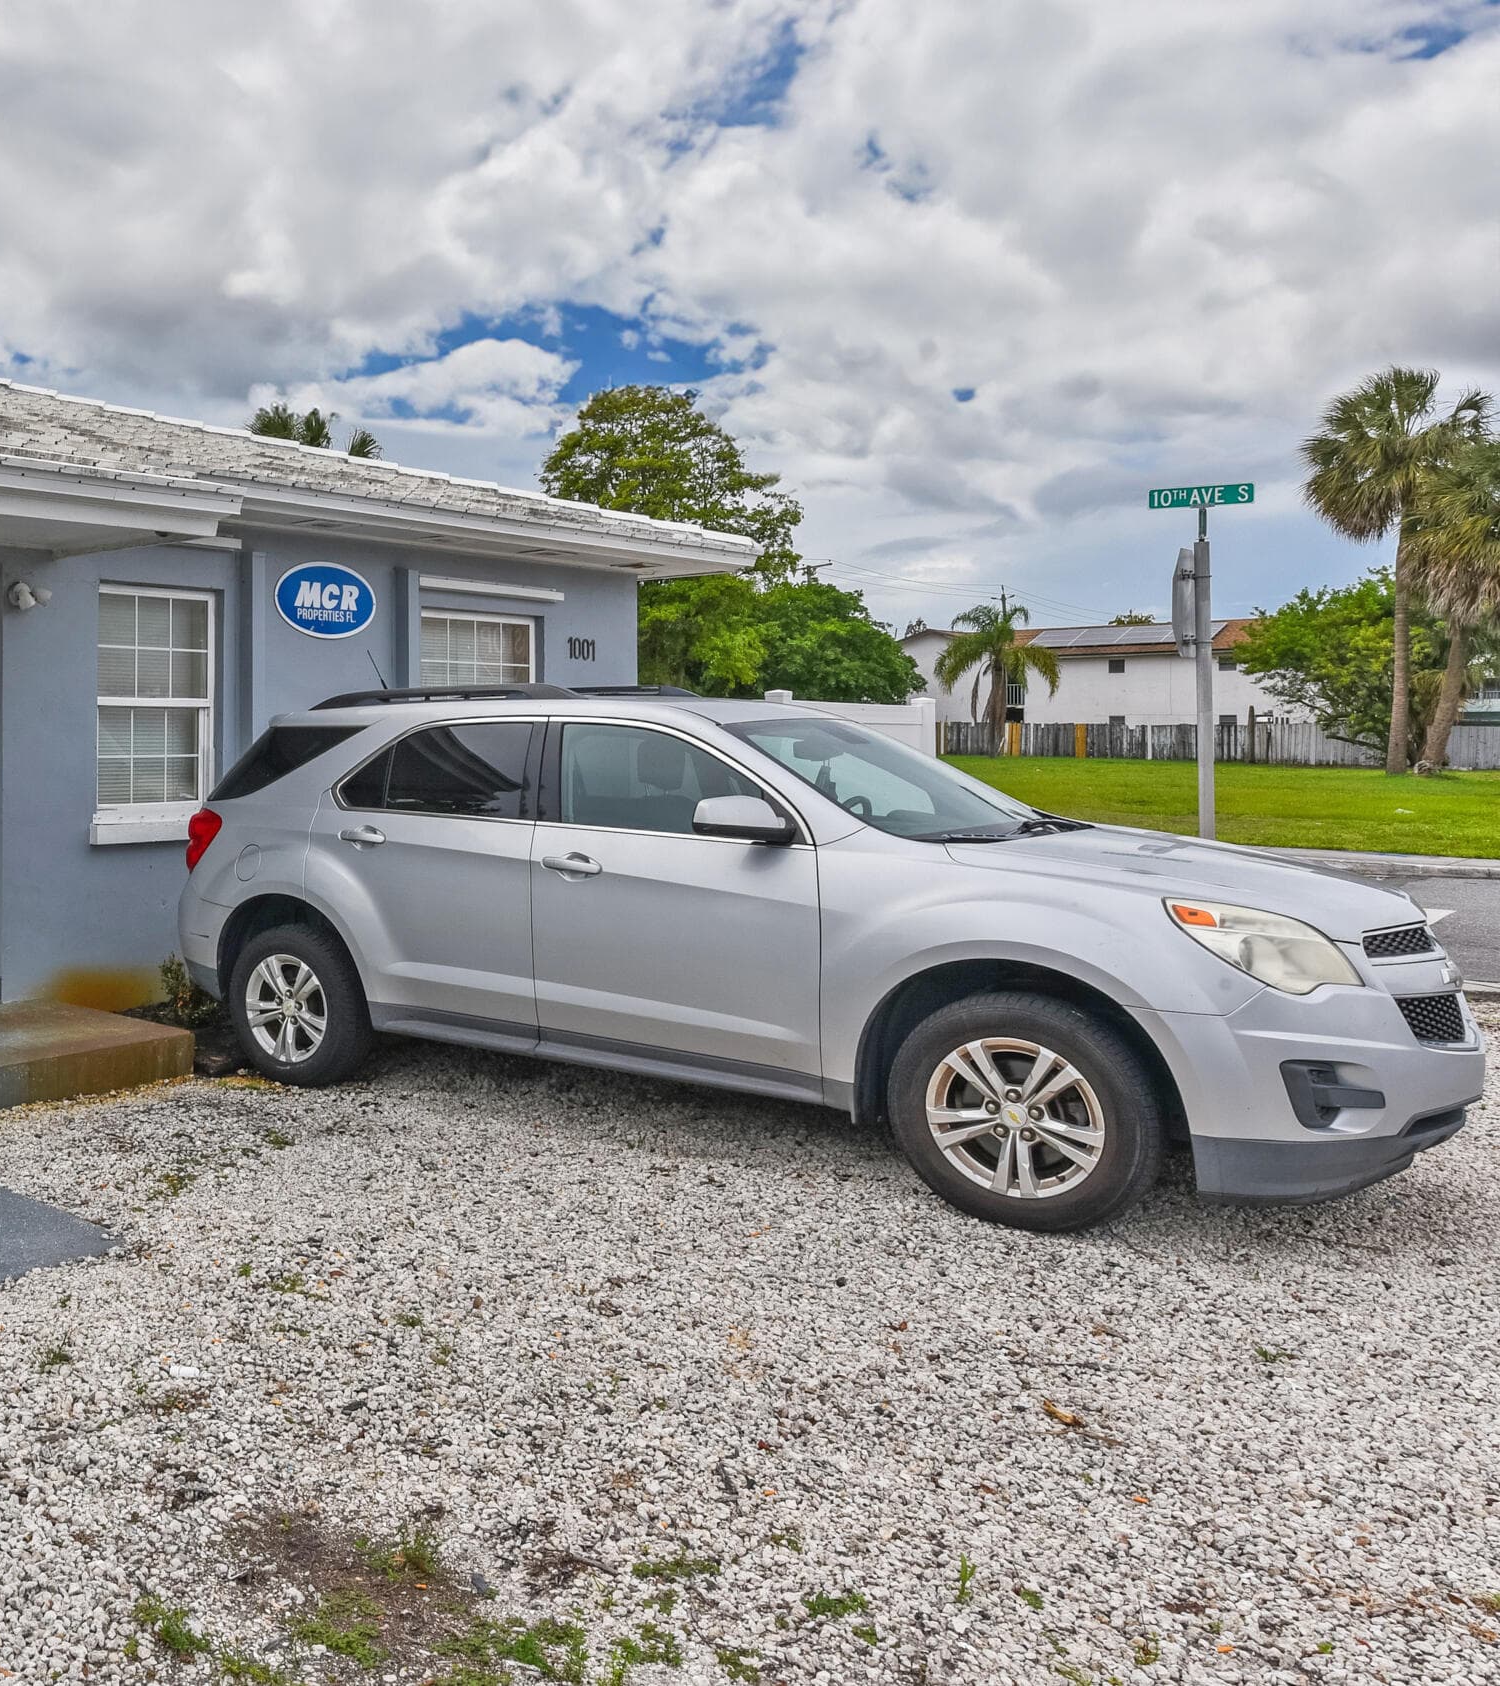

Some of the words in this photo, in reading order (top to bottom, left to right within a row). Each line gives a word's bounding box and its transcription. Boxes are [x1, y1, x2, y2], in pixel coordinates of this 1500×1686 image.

[1153, 490, 1187, 507] 10TH
[1189, 486, 1225, 505] AVE
[1237, 485, 1249, 502] S
[294, 580, 360, 611] MCR
[297, 608, 344, 623] PROPERTIES
[567, 636, 595, 662] 1001
